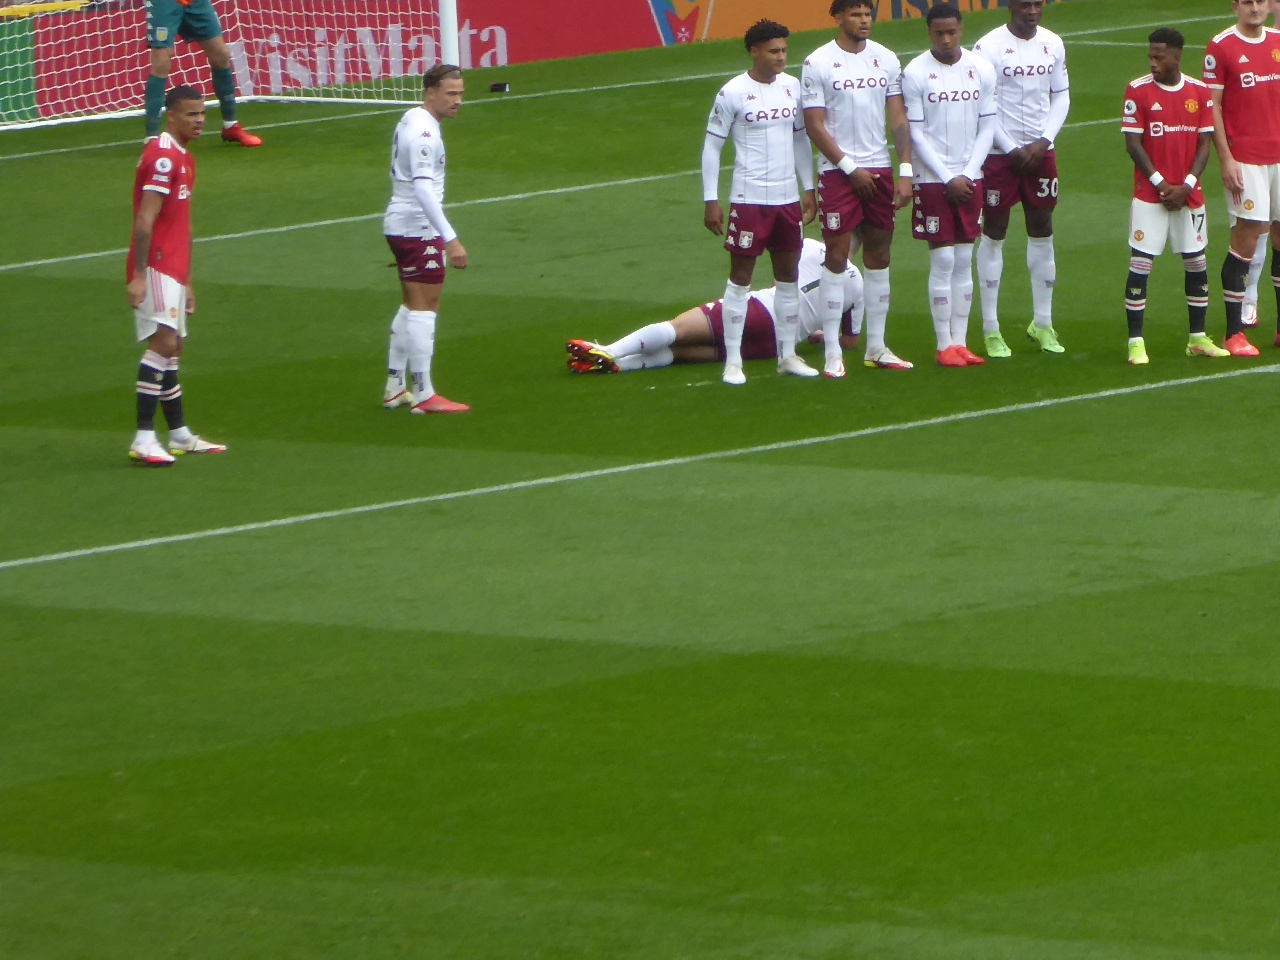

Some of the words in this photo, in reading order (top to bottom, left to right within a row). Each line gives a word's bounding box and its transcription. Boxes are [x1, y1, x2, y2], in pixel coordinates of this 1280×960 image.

[228, 16, 509, 97] VisitMata
[832, 77, 889, 91] CAZOO
[928, 89, 980, 103] CAZOO
[1036, 177, 1059, 198] 30
